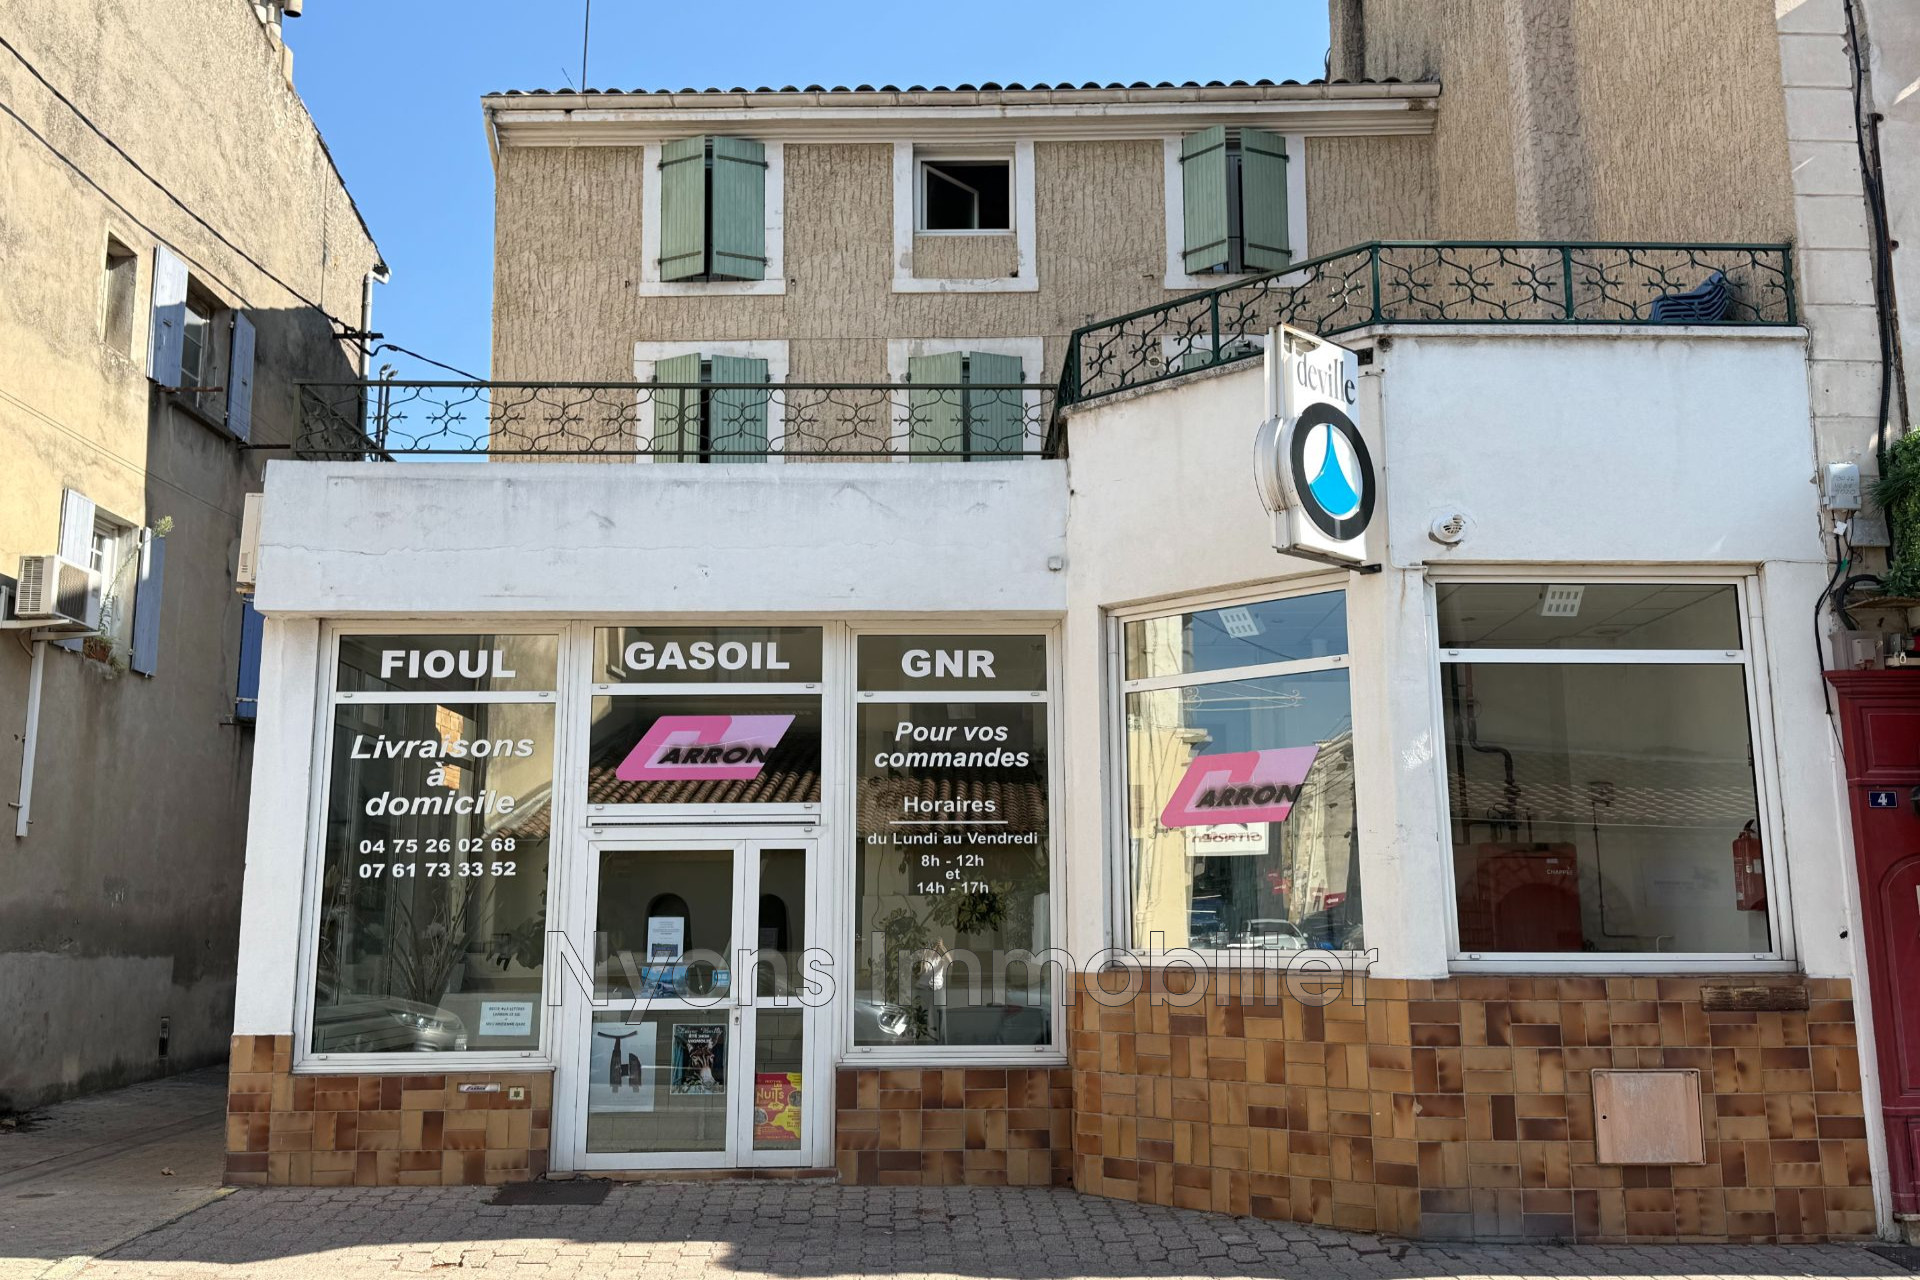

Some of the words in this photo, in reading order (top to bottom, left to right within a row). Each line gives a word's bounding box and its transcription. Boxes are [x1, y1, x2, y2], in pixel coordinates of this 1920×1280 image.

[1296, 352, 1356, 404] deville
[380, 649, 516, 679] FIOUL
[624, 641, 790, 670] GASOIL
[901, 649, 996, 678] GNR
[894, 722, 957, 742] Pour
[964, 726, 1009, 742] vos
[350, 734, 535, 759] Livraisons
[874, 747, 1030, 768] commandes
[426, 761, 446, 787] à
[364, 790, 516, 816] domicile
[904, 796, 996, 813] Horaires
[1877, 793, 1888, 806] 4
[359, 839, 385, 854] 04
[392, 839, 418, 854] 75
[425, 838, 451, 853] 26
[458, 838, 483, 853] 02
[490, 837, 516, 852] 68
[867, 833, 887, 845] du
[893, 833, 938, 845] Lundi
[943, 835, 962, 844] au
[967, 832, 1038, 844] Vendredi
[359, 863, 385, 878] 07
[392, 863, 416, 878] 61
[425, 862, 451, 878] 73
[458, 862, 484, 877] 33
[490, 861, 516, 877] 52
[921, 855, 940, 867] 8h
[956, 855, 984, 867] 12h
[945, 869, 961, 880] et
[917, 882, 945, 894] 14h
[961, 881, 989, 894] 17h
